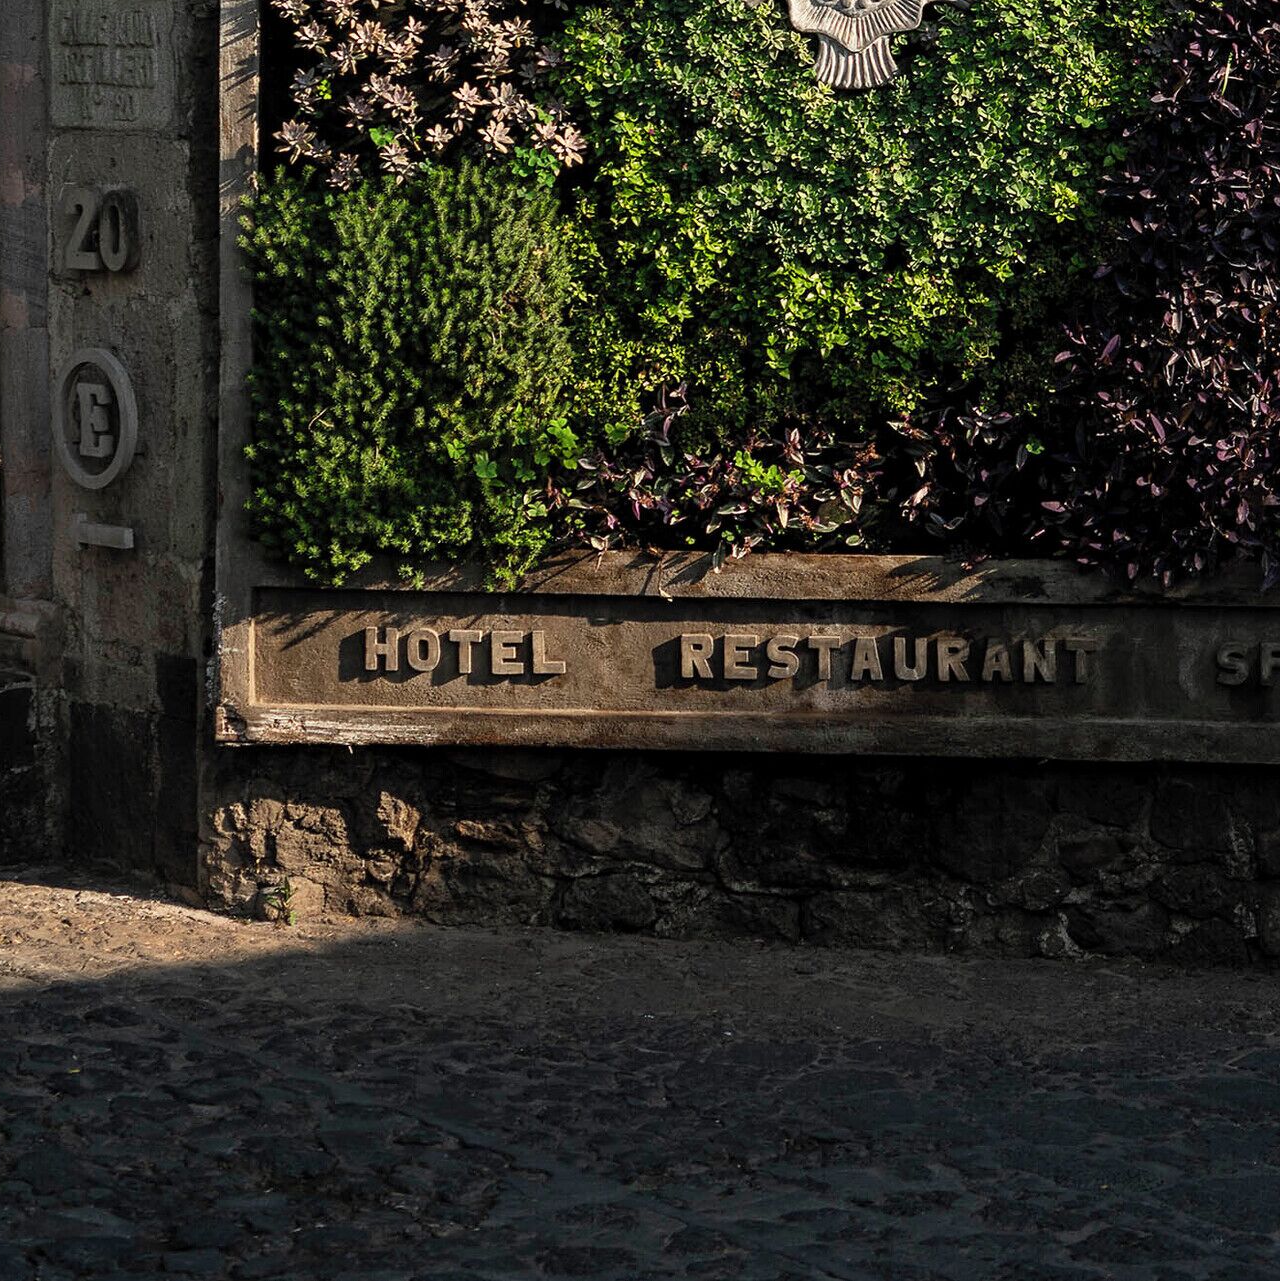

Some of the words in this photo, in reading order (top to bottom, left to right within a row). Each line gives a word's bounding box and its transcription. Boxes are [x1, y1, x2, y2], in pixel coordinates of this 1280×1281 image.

[65, 187, 133, 272] 20
[77, 382, 114, 457] E
[365, 627, 566, 674] HOTEL
[680, 633, 1102, 683] RESTAURANT
